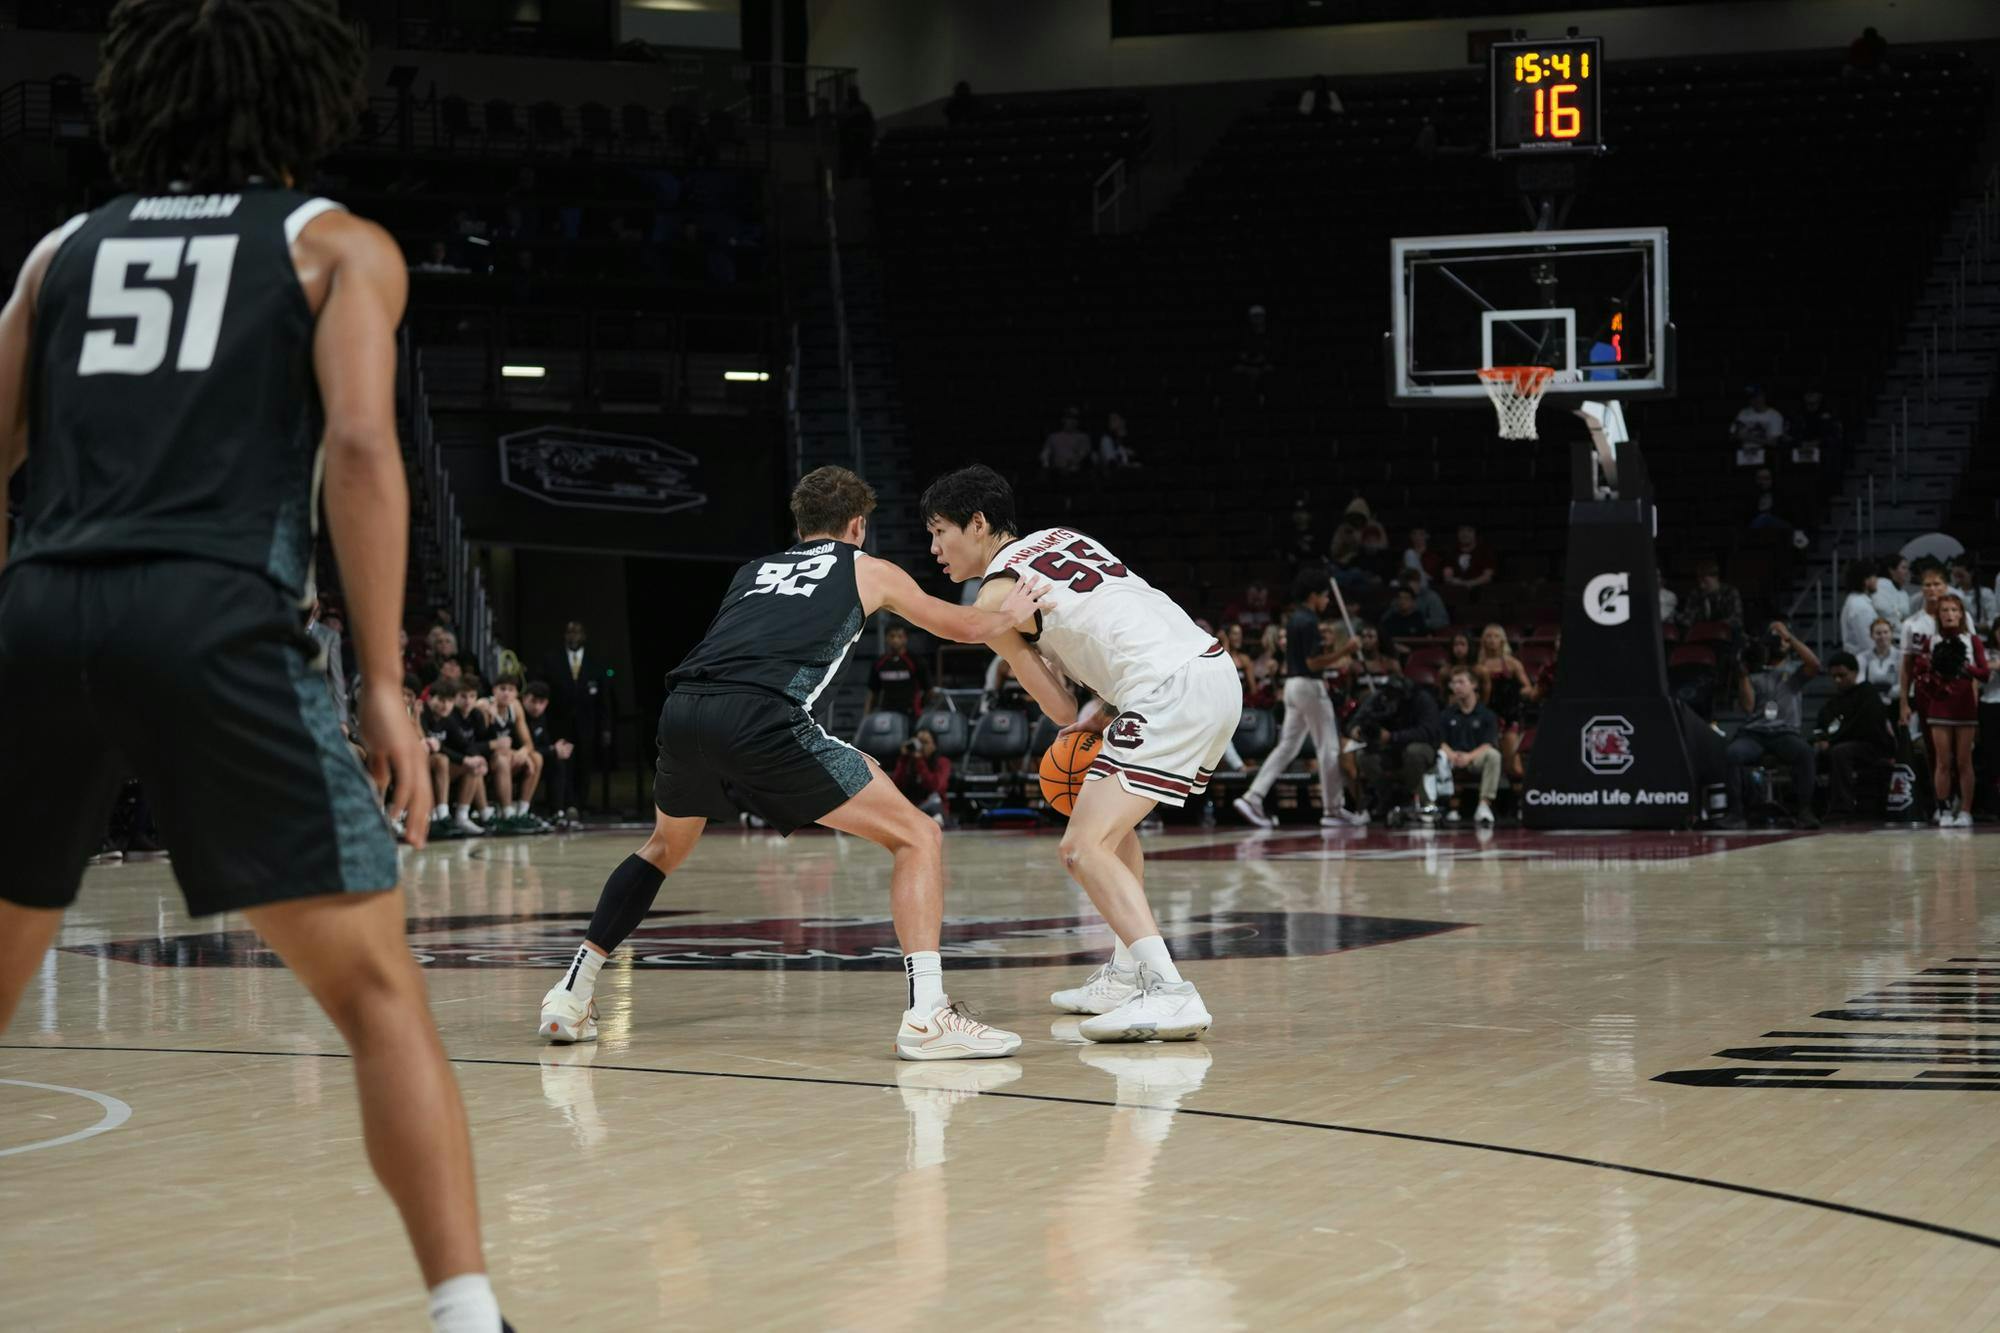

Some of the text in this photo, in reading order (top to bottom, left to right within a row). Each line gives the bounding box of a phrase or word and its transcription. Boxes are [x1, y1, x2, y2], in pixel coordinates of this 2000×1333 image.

[1515, 52, 1589, 84] 15:41
[1534, 84, 1581, 138] 16
[129, 193, 242, 221] MORGAN
[77, 234, 240, 376] 51
[1028, 539, 1129, 593] 55
[1526, 789, 1689, 806] Colonial Life Arena
